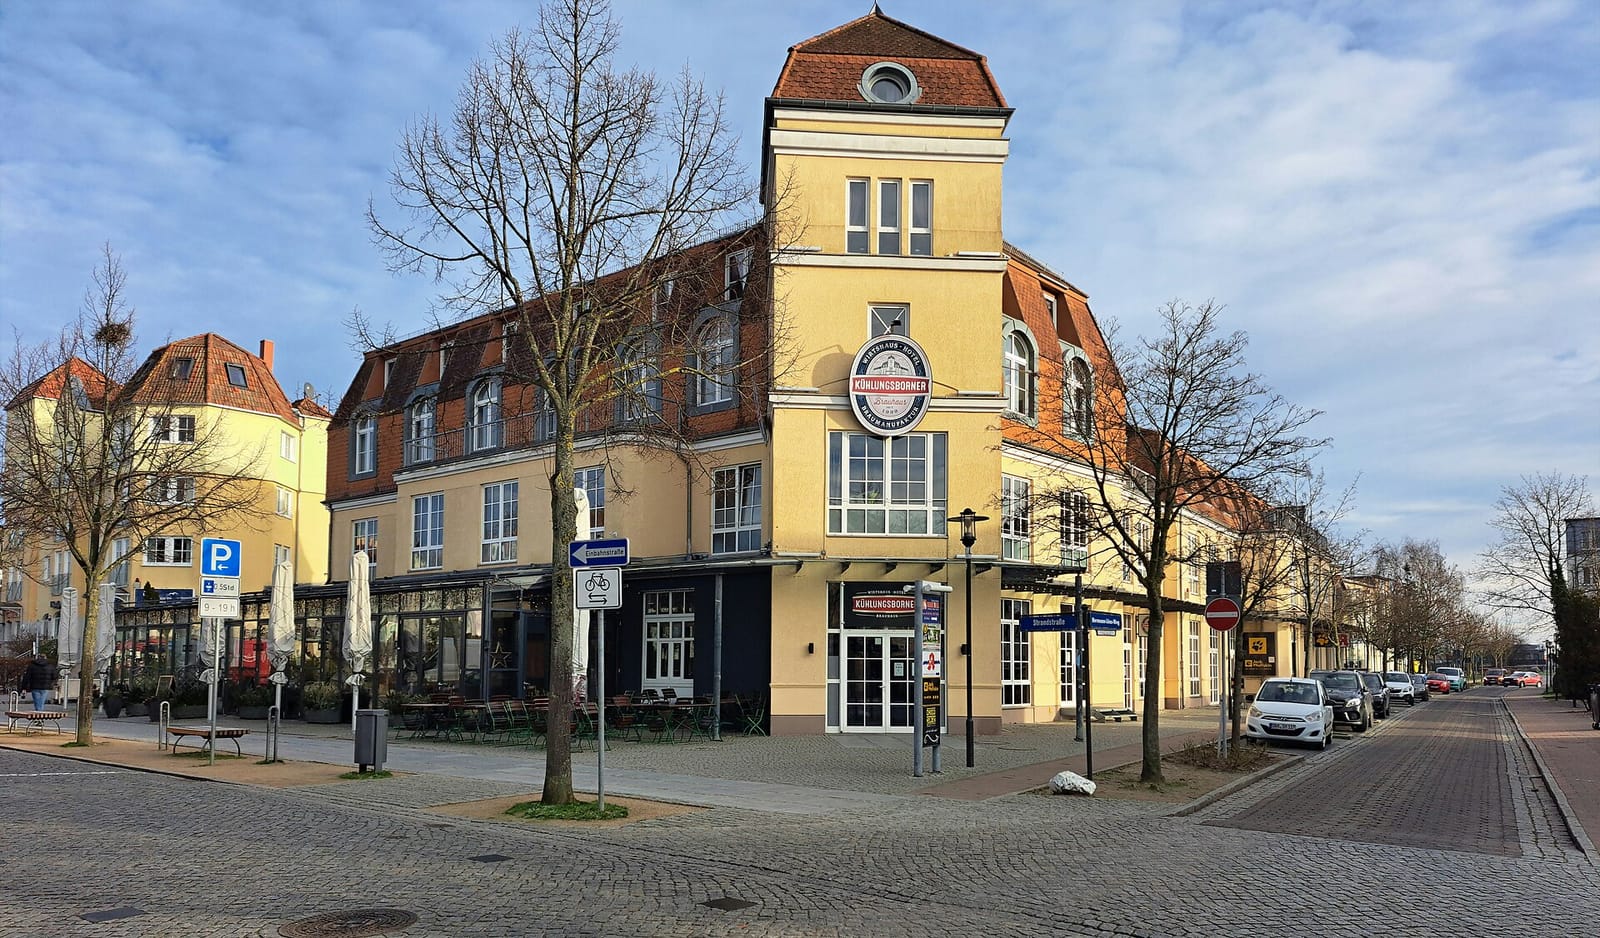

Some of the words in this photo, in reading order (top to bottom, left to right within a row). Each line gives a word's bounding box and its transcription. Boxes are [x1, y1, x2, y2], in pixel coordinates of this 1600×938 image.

[862, 342, 898, 365] WIRTSHAUS
[902, 346, 921, 366] HOTEL
[855, 379, 926, 391] KÜHLUNGSBORNER
[861, 405, 919, 428] BRAUMANUFAKTUR
[211, 544, 232, 571] P
[586, 549, 624, 557] Einbahnstraße
[204, 603, 210, 612] 9
[219, 604, 228, 612] 19
[855, 599, 914, 609] KÜHLUNGSBORNE
[1032, 618, 1065, 626] Strandstraße
